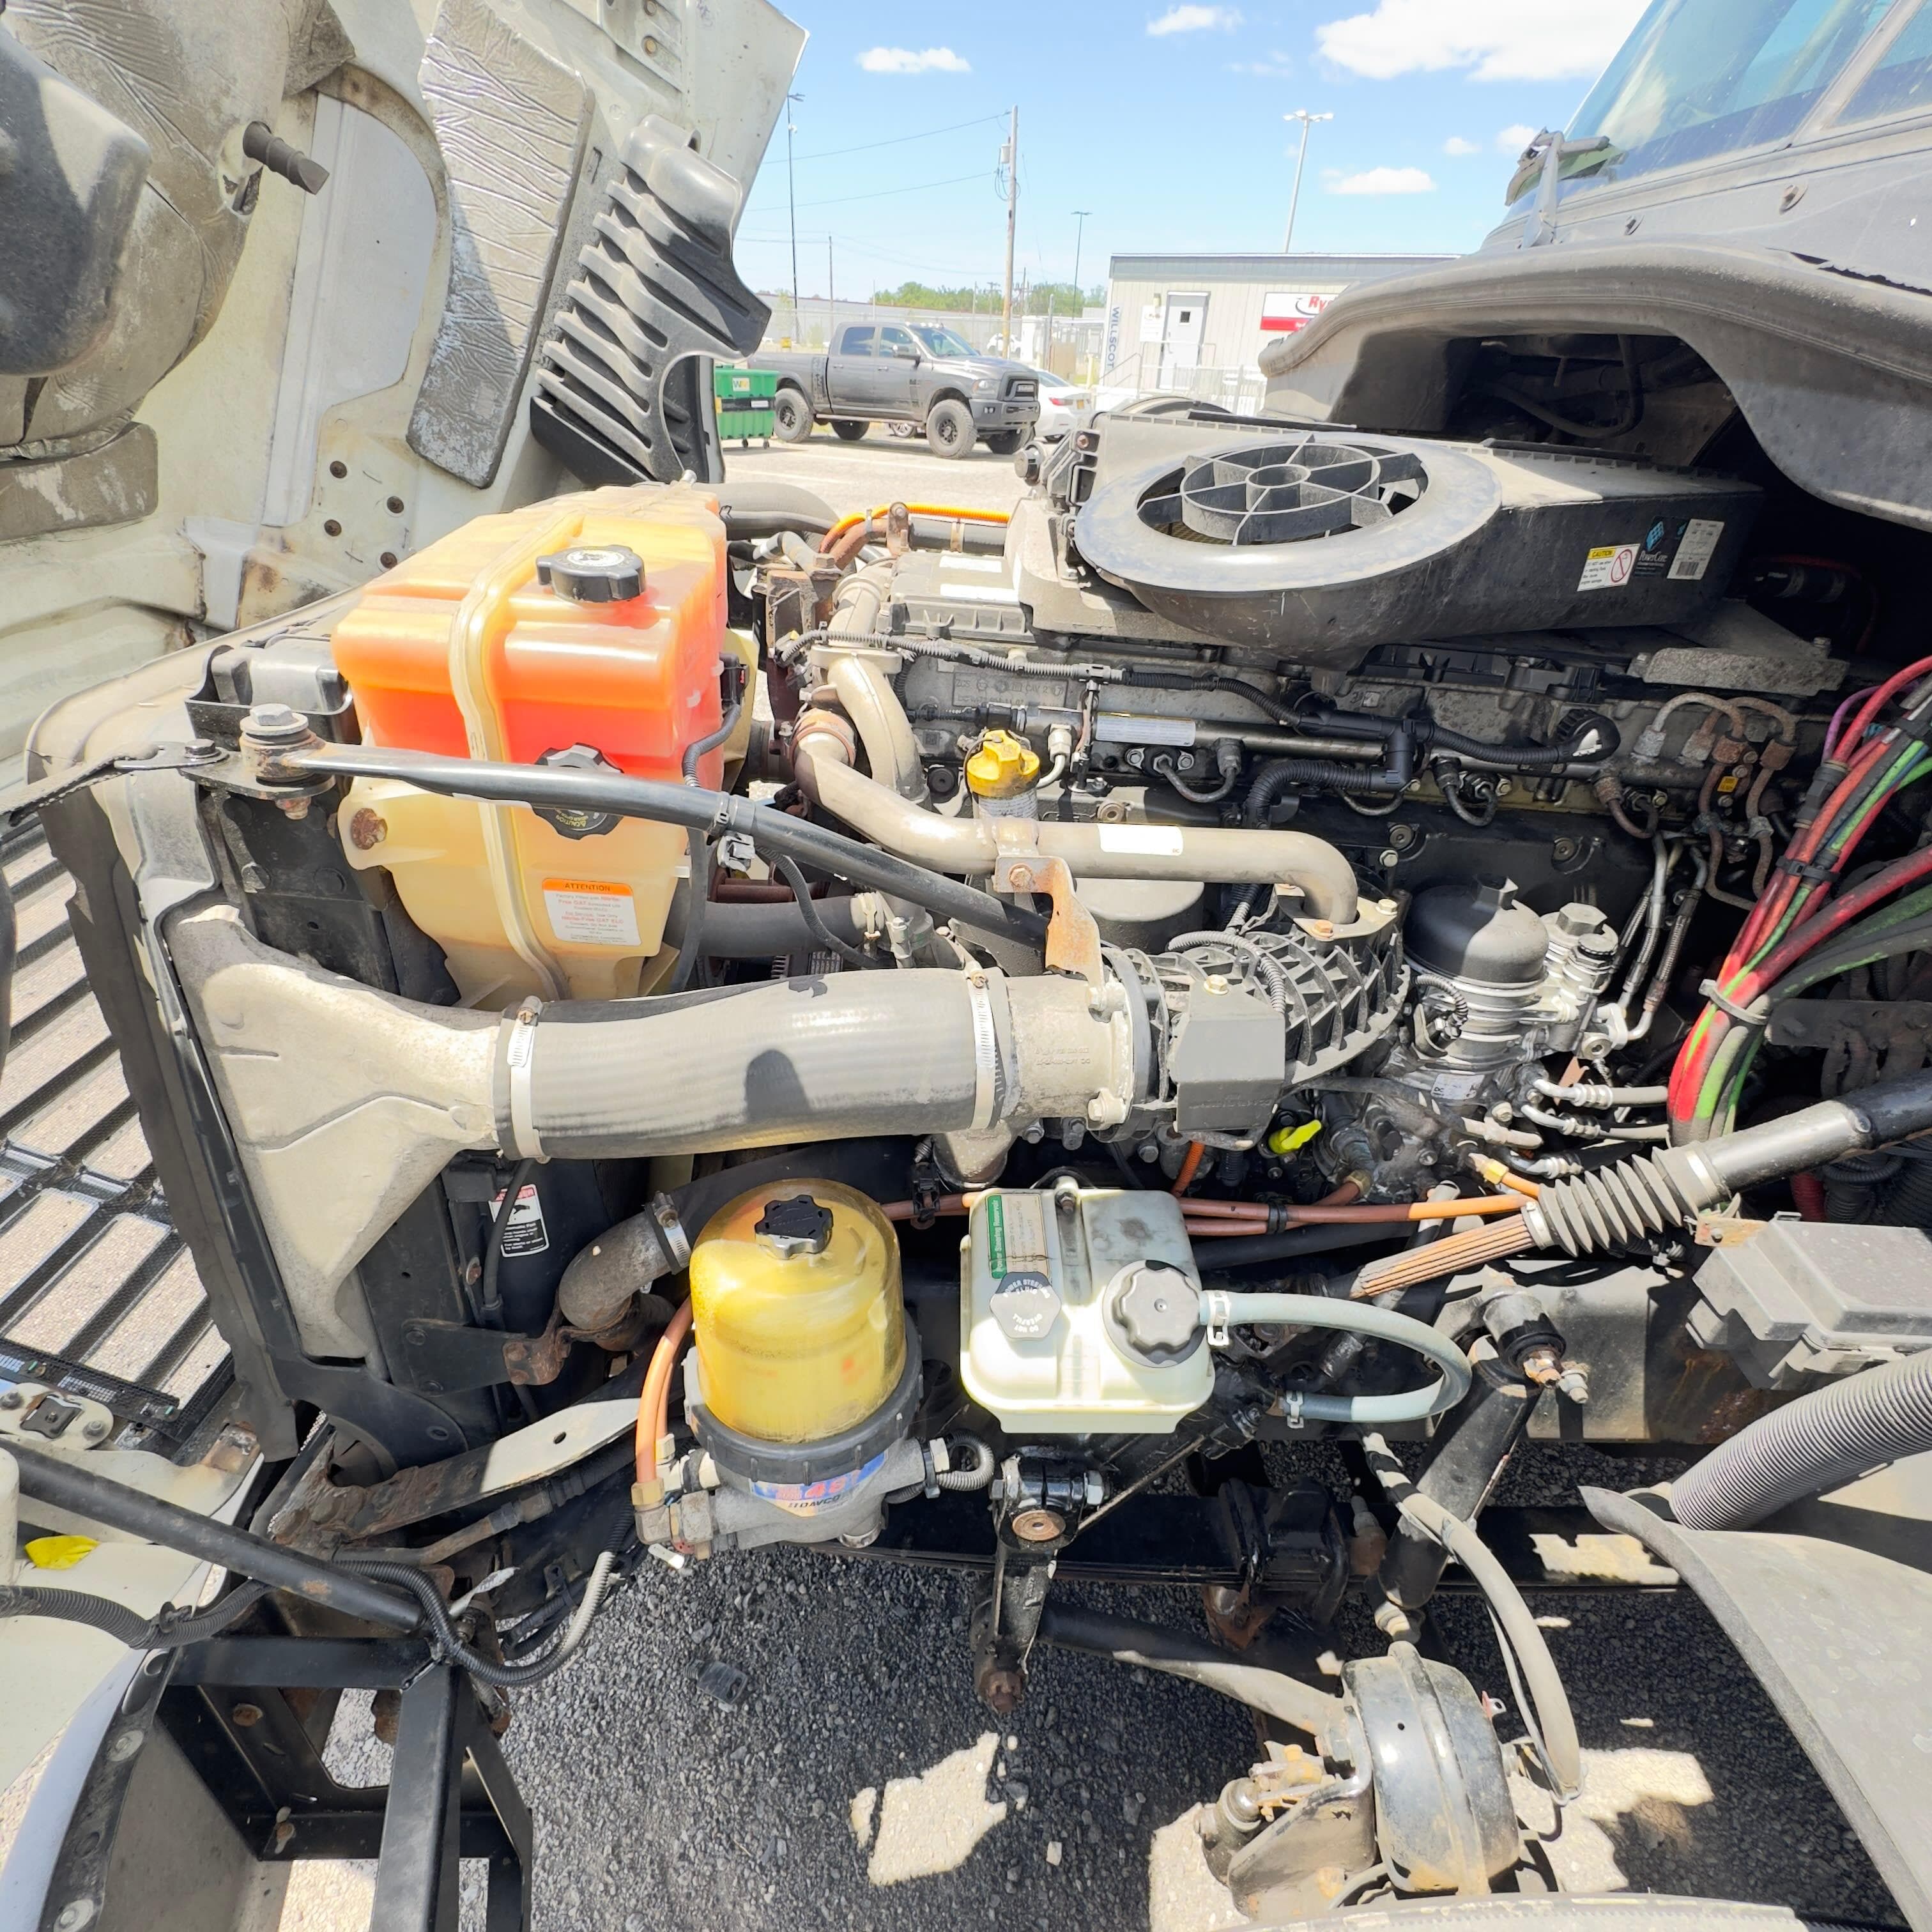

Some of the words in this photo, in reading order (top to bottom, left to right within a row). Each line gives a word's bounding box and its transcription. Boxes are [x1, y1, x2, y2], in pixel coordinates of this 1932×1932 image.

[1107, 307, 1119, 368] WILLSCOT
[555, 814, 580, 827] CAUTION
[565, 882, 611, 891] ATTENTION
[992, 1200, 1000, 1227] Reservoir
[1002, 1280, 1022, 1298] POWER
[1023, 1279, 1050, 1299] STEERING
[1013, 1313, 1043, 1326] OVERFILL
[1014, 1324, 1027, 1333] NOT
[1029, 1324, 1039, 1333] DO
